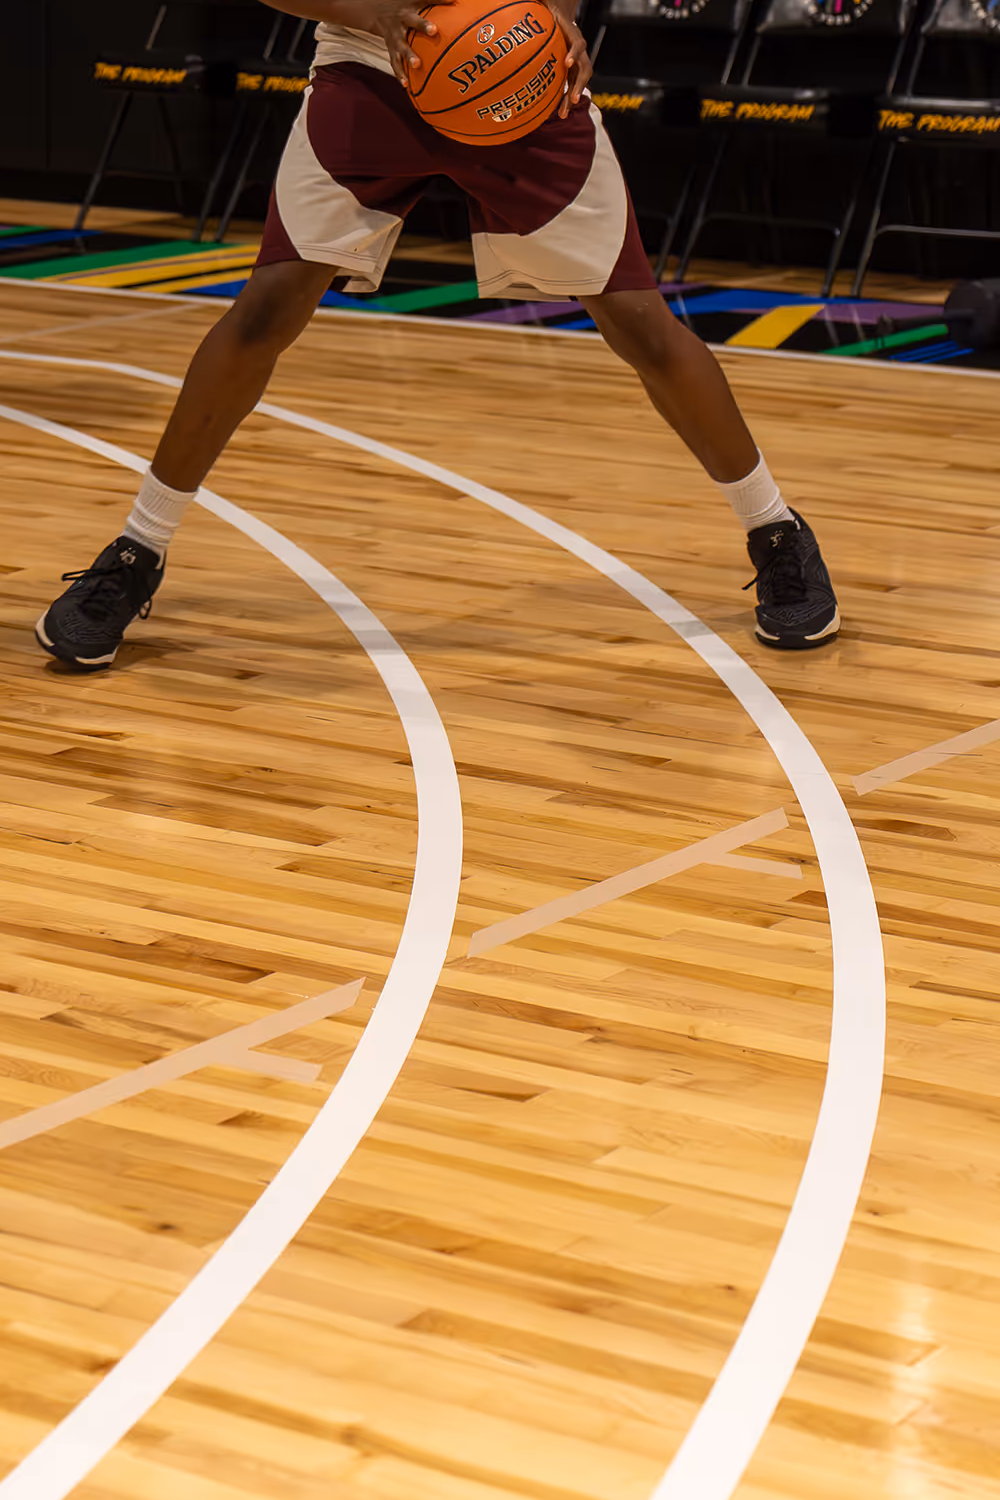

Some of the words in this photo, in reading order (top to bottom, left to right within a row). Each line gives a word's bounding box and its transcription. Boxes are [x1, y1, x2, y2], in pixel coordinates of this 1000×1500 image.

[448, 12, 546, 94] SPALDING
[476, 53, 558, 120] PRECISION
[515, 71, 556, 113] 1000
[700, 99, 733, 118] THE
[735, 102, 815, 123] PROGRAM
[878, 109, 915, 132] THE
